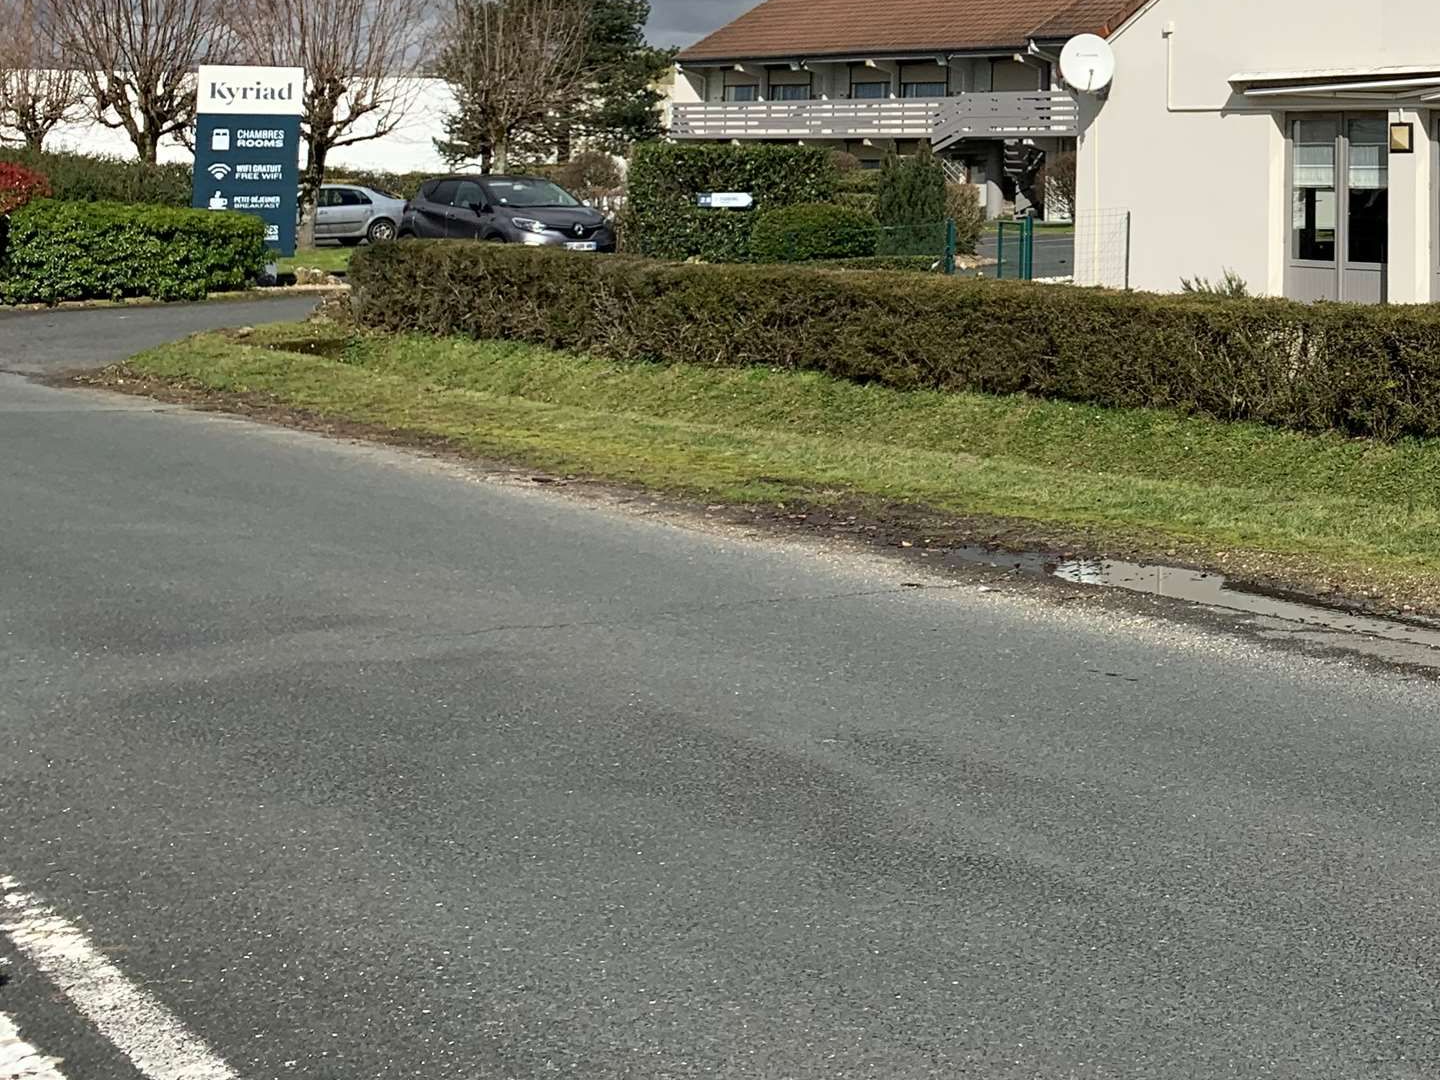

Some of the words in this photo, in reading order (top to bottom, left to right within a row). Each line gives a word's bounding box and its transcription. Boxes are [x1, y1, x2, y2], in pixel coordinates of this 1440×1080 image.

[210, 81, 292, 105] Kyriad
[237, 129, 284, 139] CHAMBRES
[237, 139, 284, 147] ROOMS
[236, 164, 252, 172] WIFI
[252, 164, 281, 172] GRATUIT
[235, 172, 259, 180] FREE
[261, 172, 282, 180] WIFI
